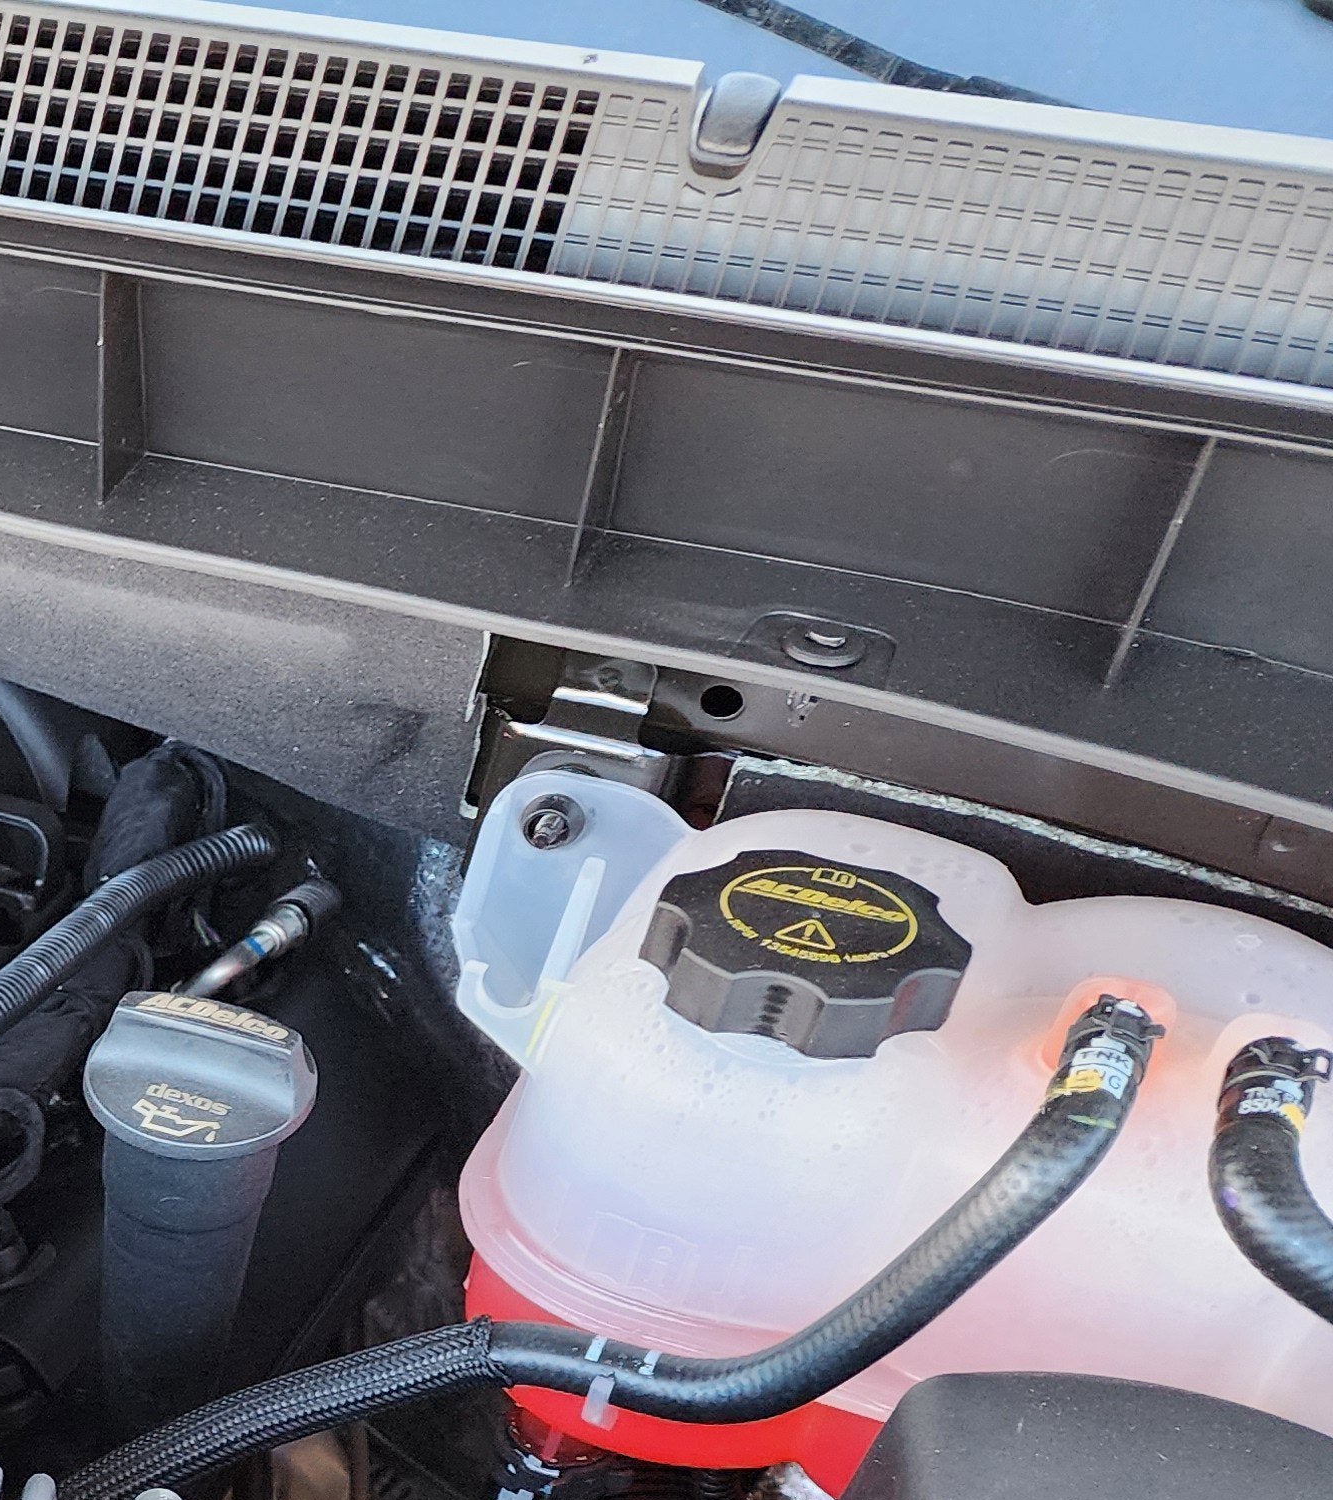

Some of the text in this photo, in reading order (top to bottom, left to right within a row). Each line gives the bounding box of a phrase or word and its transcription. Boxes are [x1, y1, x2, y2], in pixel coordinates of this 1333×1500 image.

[736, 878, 909, 922] ACDelco
[135, 992, 290, 1041] ACDelco
[1079, 1050, 1131, 1071] TNK
[146, 1082, 233, 1116] dexos
